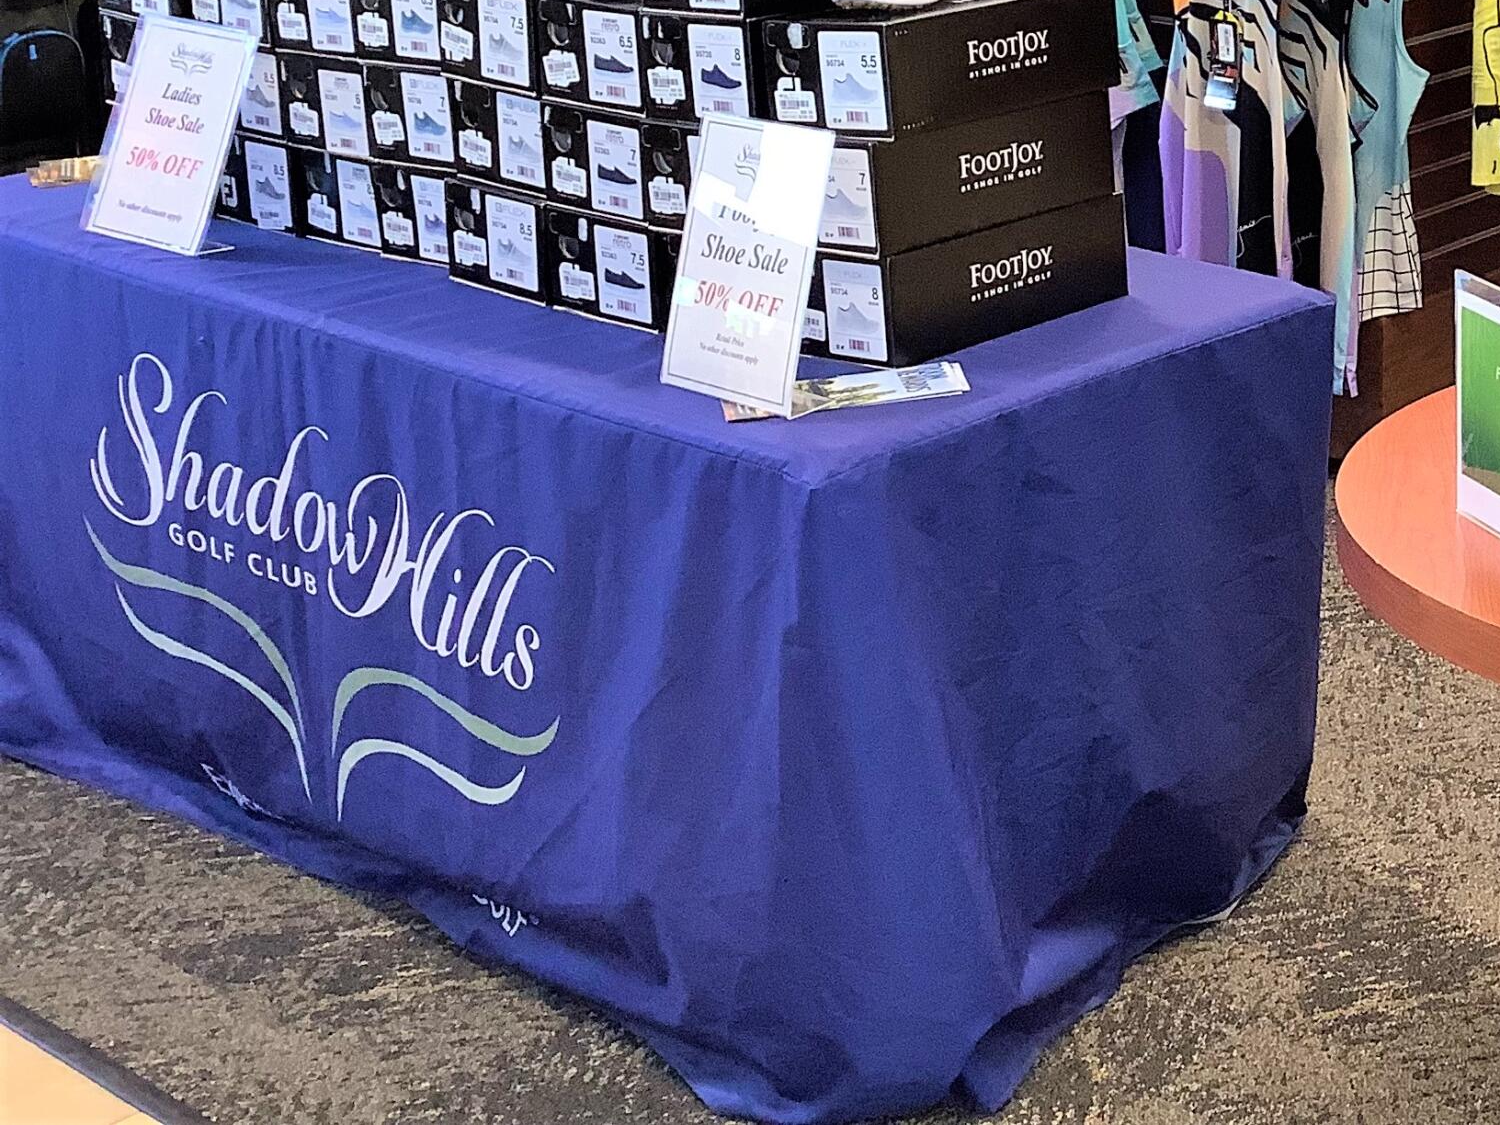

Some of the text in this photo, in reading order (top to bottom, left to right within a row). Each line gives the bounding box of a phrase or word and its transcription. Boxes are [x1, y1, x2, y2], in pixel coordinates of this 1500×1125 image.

[510, 16, 524, 30] 7.5
[619, 35, 633, 49] 6.5
[734, 48, 741, 61] 8
[861, 55, 877, 68] 5.5
[981, 65, 1007, 77] SHOE
[1011, 61, 1022, 70] IN
[1024, 55, 1048, 67] GOLF
[162, 83, 203, 107] Ladies
[355, 93, 361, 105] 6
[439, 96, 445, 108] 7
[145, 108, 204, 135] Shoe Sale
[630, 149, 636, 161] 7
[126, 146, 204, 180] 50% OFF
[858, 173, 866, 186] 7
[973, 177, 1000, 190] SHOE
[1003, 173, 1014, 182] IN
[1018, 166, 1043, 179] GOLF
[519, 223, 533, 237] 8.5
[630, 252, 645, 267] 7.5
[701, 233, 789, 275] Shoe Sale
[984, 286, 1009, 299] SHOE
[1013, 281, 1024, 290] IN
[1027, 272, 1052, 285] GOLF
[694, 280, 784, 318] 50% OFF
[871, 287, 879, 301] 8
[91, 353, 555, 691] Shadow Hills
[169, 524, 318, 596] GOLF CLUB
